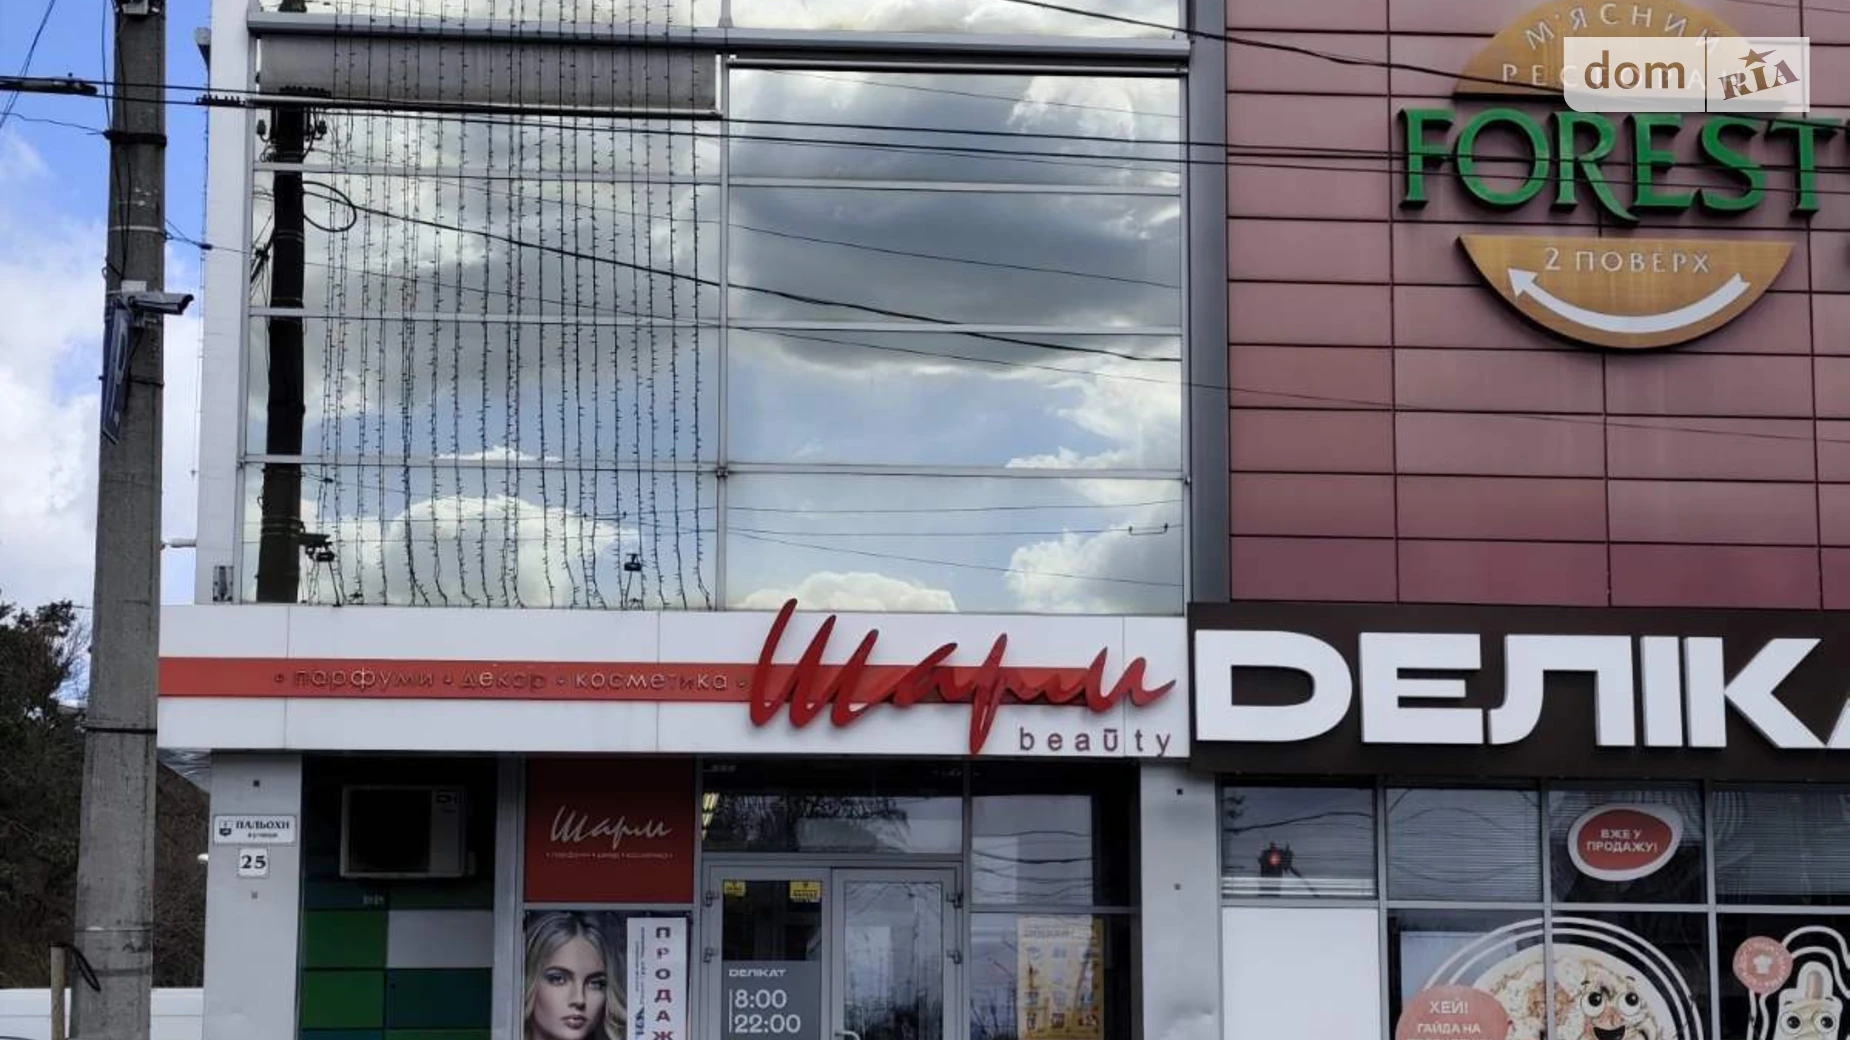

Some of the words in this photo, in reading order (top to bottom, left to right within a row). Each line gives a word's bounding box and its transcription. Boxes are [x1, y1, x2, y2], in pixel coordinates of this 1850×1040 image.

[1399, 107, 1842, 223] FOREST
[1545, 247, 1561, 271] 2
[1576, 250, 1709, 273] ПОВЕРХ
[1195, 629, 1850, 750] DЕЛІК
[1601, 828, 1631, 840] ВЖЕ
[1633, 828, 1642, 840] У
[1587, 841, 1658, 853] ПРОДАЖУ!
[241, 854, 266, 870] 25
[734, 989, 788, 1009] 8:00
[734, 1014, 802, 1034] 22:00
